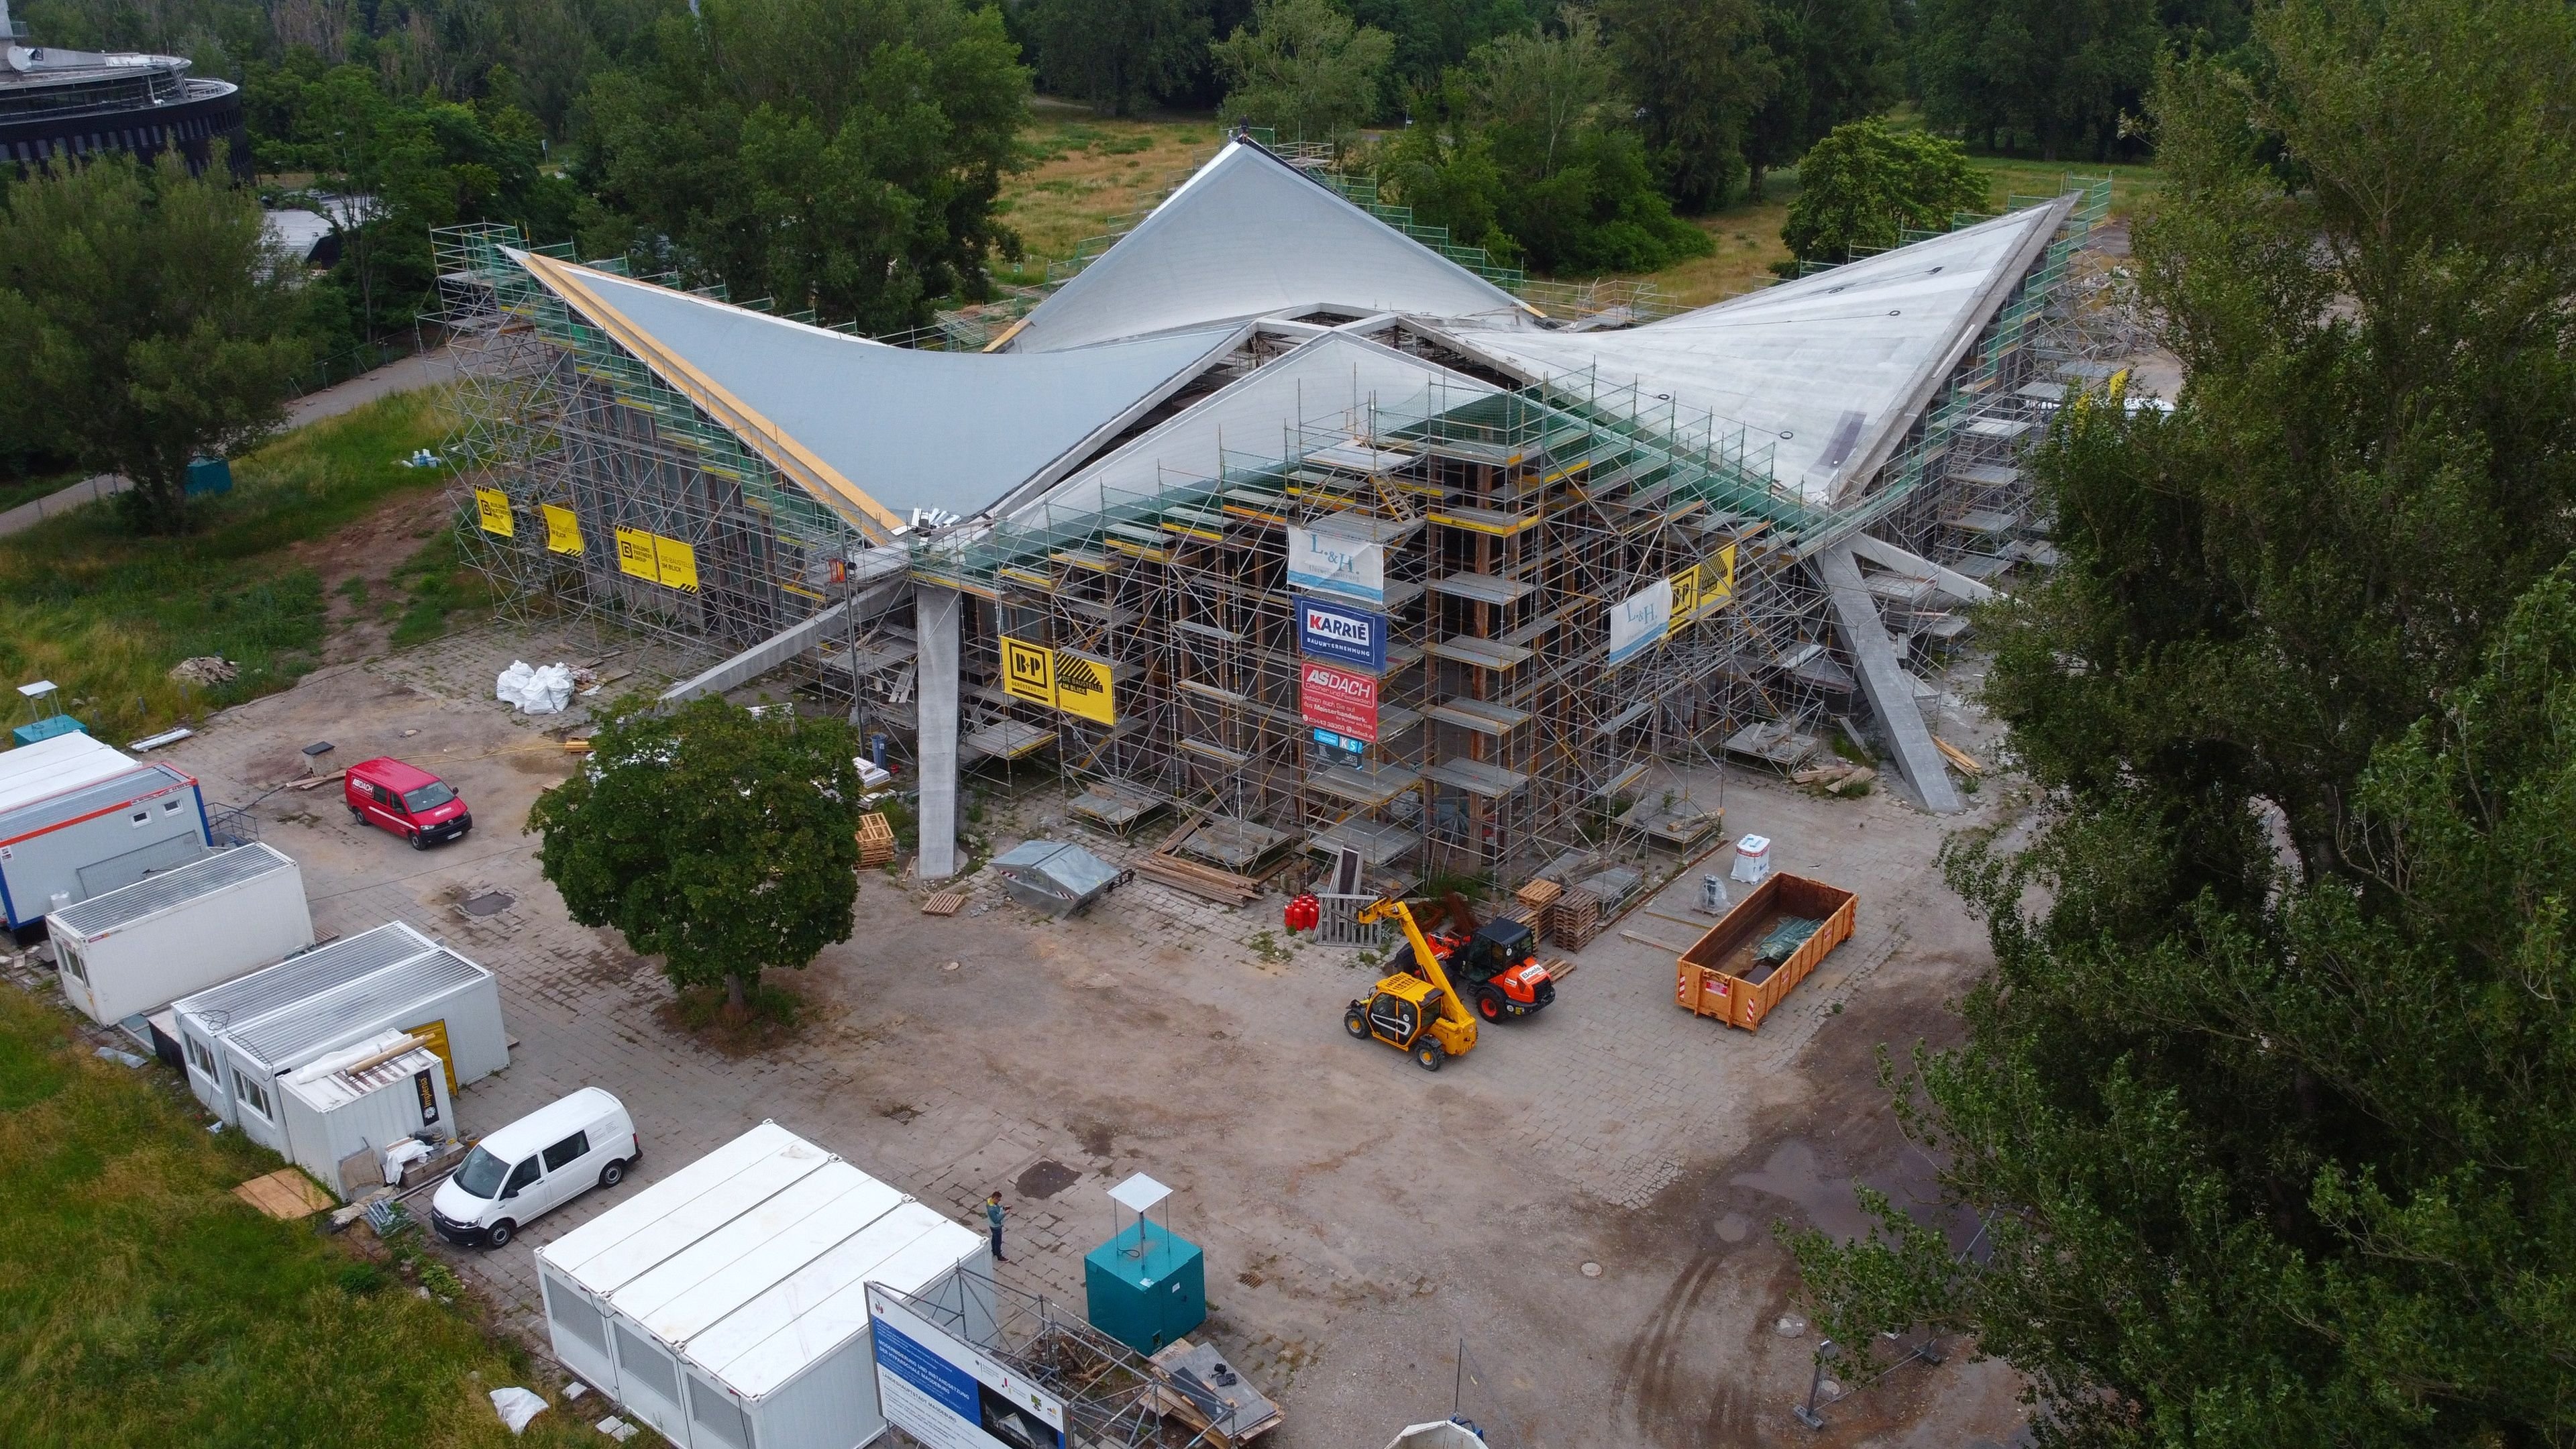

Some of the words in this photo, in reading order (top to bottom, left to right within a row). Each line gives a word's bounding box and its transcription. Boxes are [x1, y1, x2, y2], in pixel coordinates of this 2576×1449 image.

[668, 564, 682, 574] BLICK
[1310, 614, 1366, 641] KARRIÉ
[1307, 637, 1370, 657] BAUUNTERNEHMUNG
[1016, 653, 1040, 677] B+P
[1070, 685, 1086, 694] BLICK
[1072, 678, 1102, 692] BAUSTELLE
[1305, 683, 1329, 693] Dächer
[1341, 692, 1371, 705] Fassaden
[1307, 669, 1371, 698] ASDACH
[1303, 693, 1322, 703] Setzen
[1322, 700, 1335, 708] auch
[1314, 704, 1366, 723] Meisterhandwerk.
[1522, 967, 1542, 979] Boels
[878, 1339, 916, 1366] MODERNISIERUNG
[918, 1364, 927, 1373] UND
[928, 1371, 970, 1400] INSTANDSETZUNG
[879, 1347, 888, 1355] DER
[921, 1373, 950, 1394] MAGDEBURG
[881, 1372, 927, 1403] LANDESHAUPTSTADT
[928, 1402, 957, 1423] MAGDEBURG
